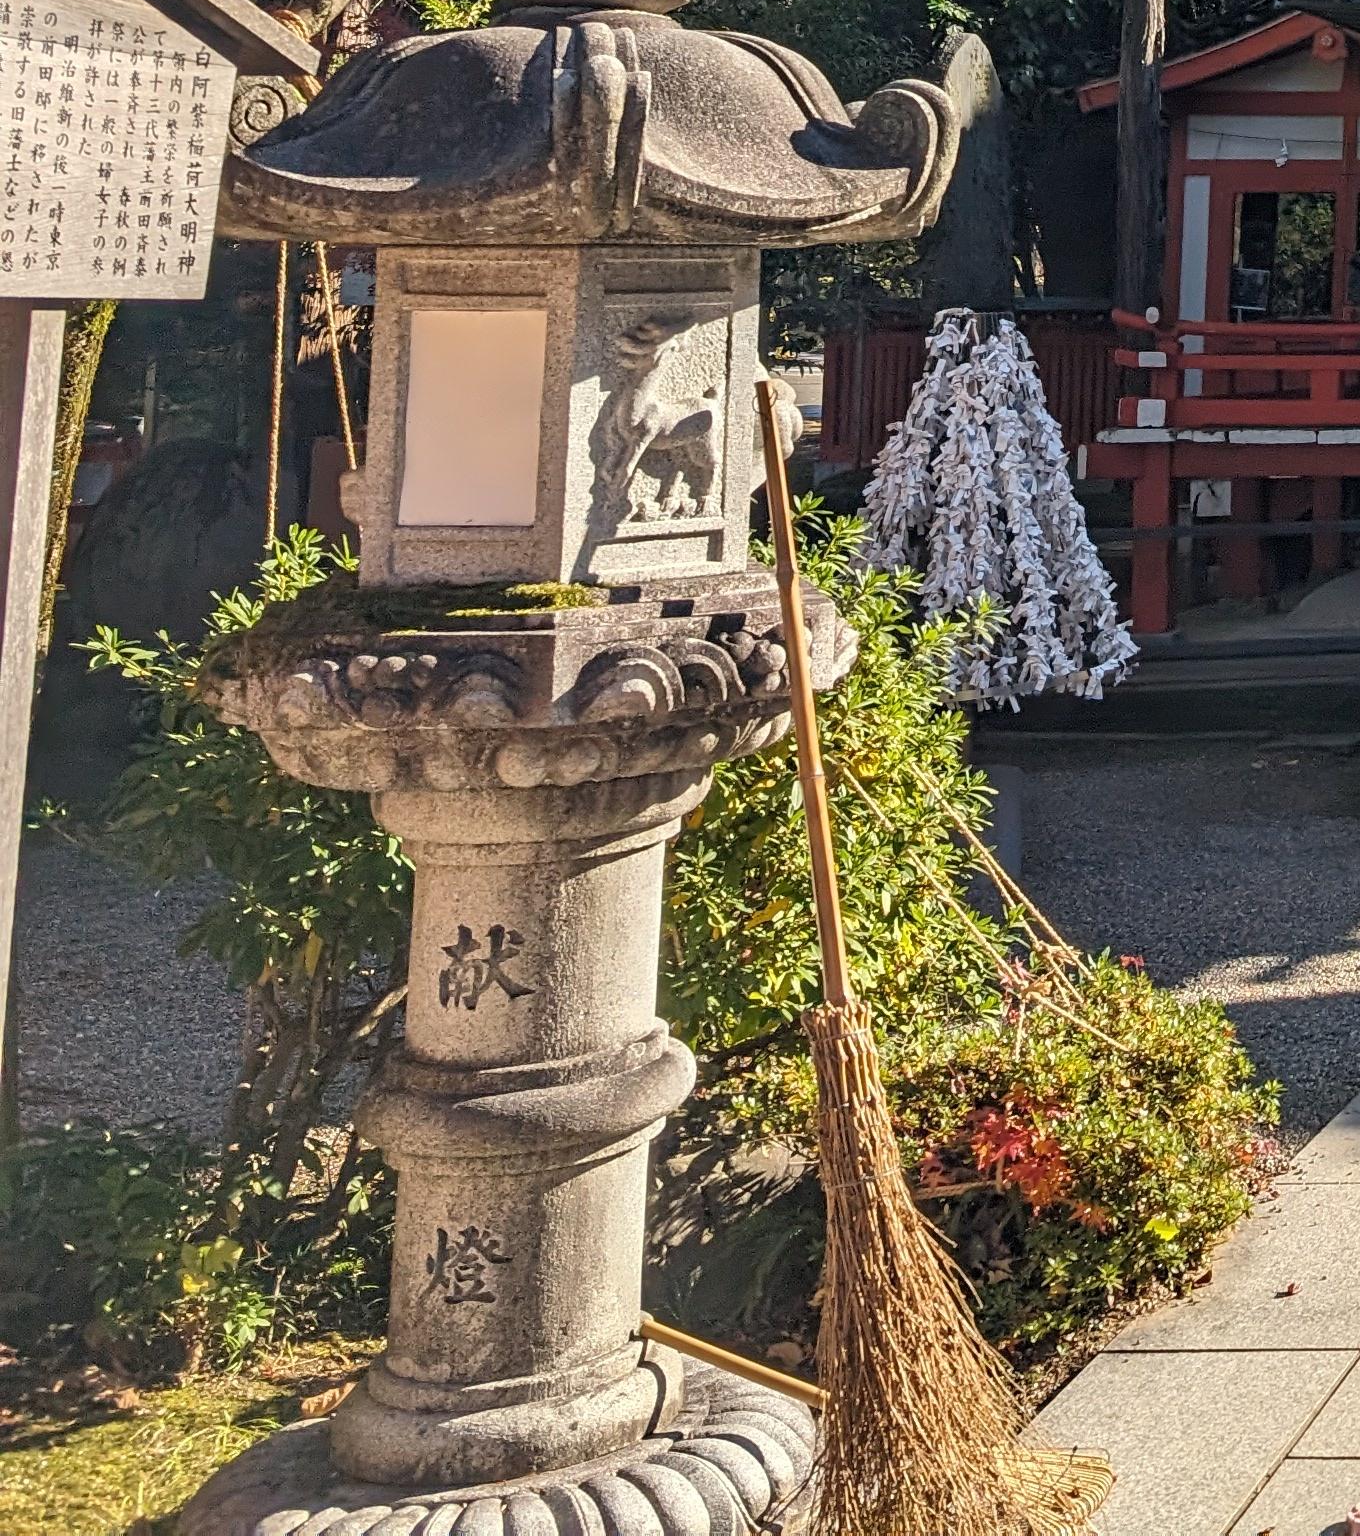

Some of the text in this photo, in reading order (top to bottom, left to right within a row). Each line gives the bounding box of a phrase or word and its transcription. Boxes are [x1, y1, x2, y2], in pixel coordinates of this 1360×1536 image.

[23, 12, 57, 269] の前田邸に移されたが
[45, 35, 79, 271] 明治維新の後一時東京
[439, 924, 536, 1009] 献
